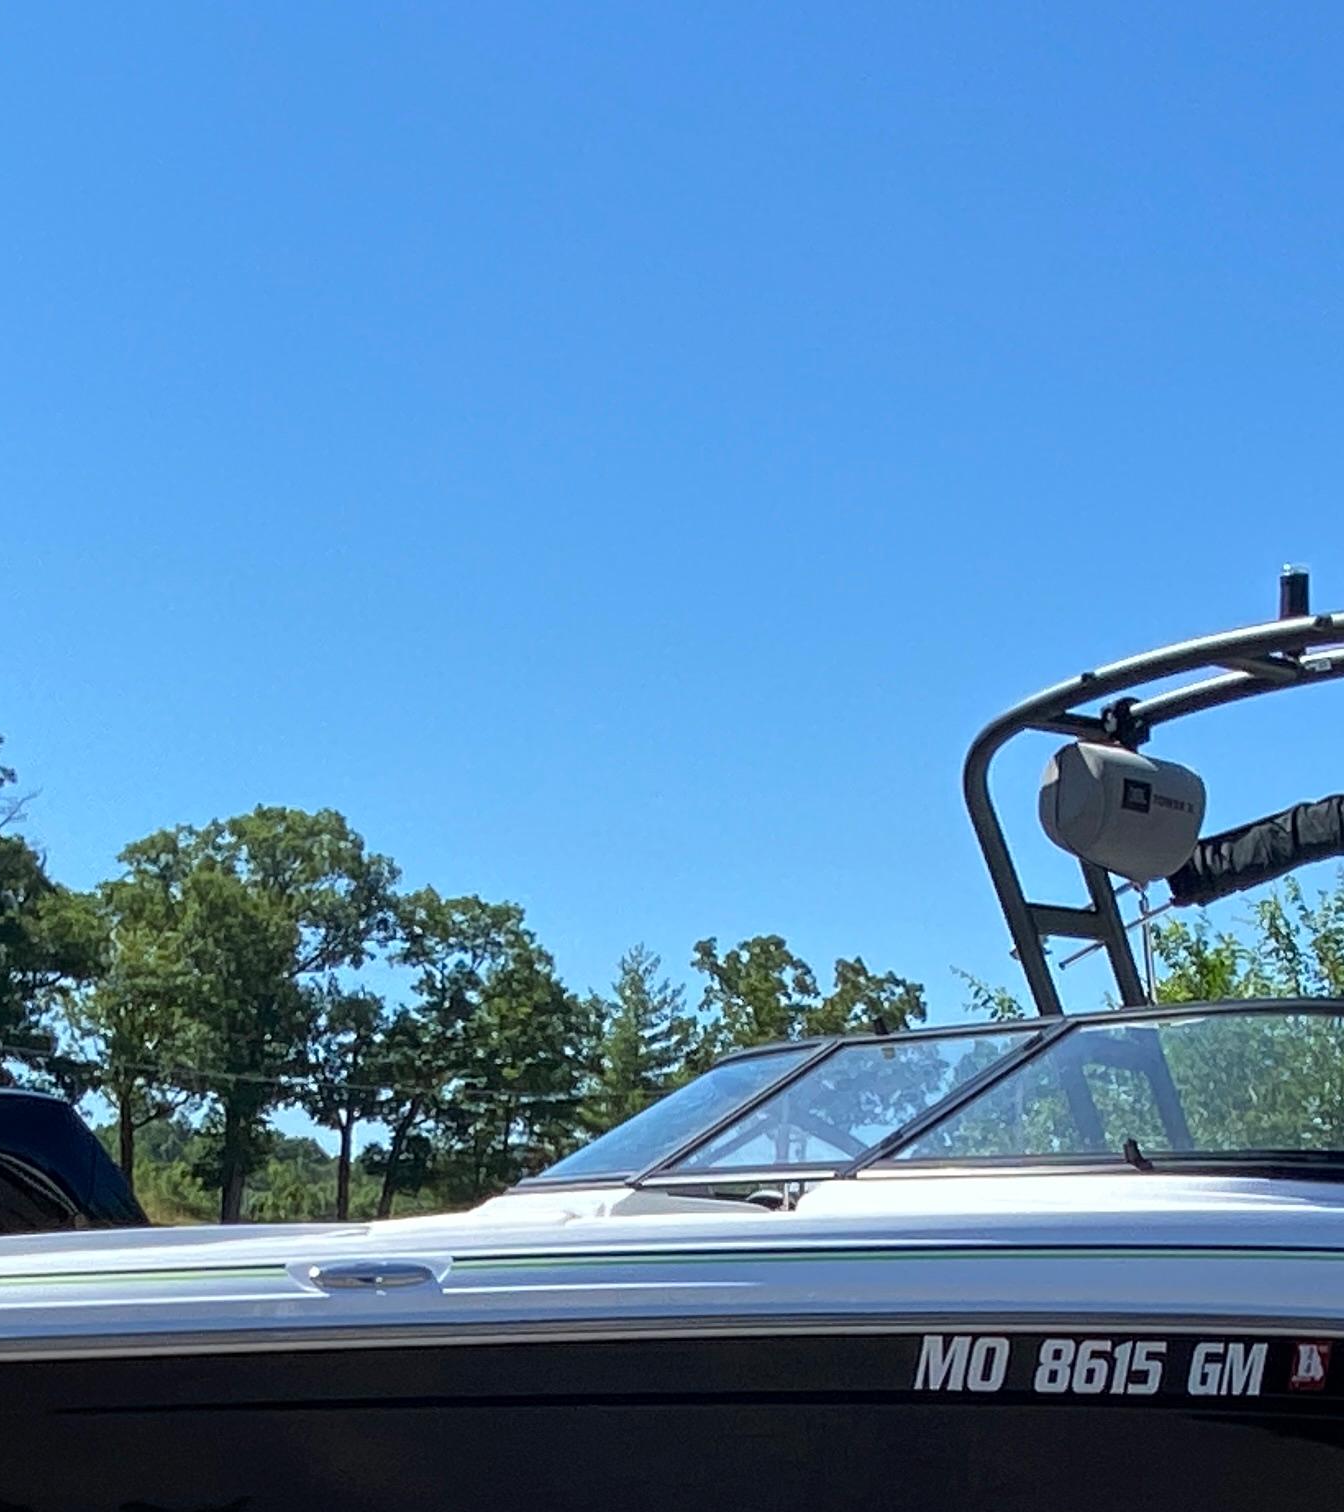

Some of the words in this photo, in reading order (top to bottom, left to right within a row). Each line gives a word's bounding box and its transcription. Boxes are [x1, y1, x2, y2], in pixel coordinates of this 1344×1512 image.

[914, 1335, 1009, 1392] MO
[1034, 1338, 1167, 1395] 8615
[1188, 1341, 1268, 1396] GM
